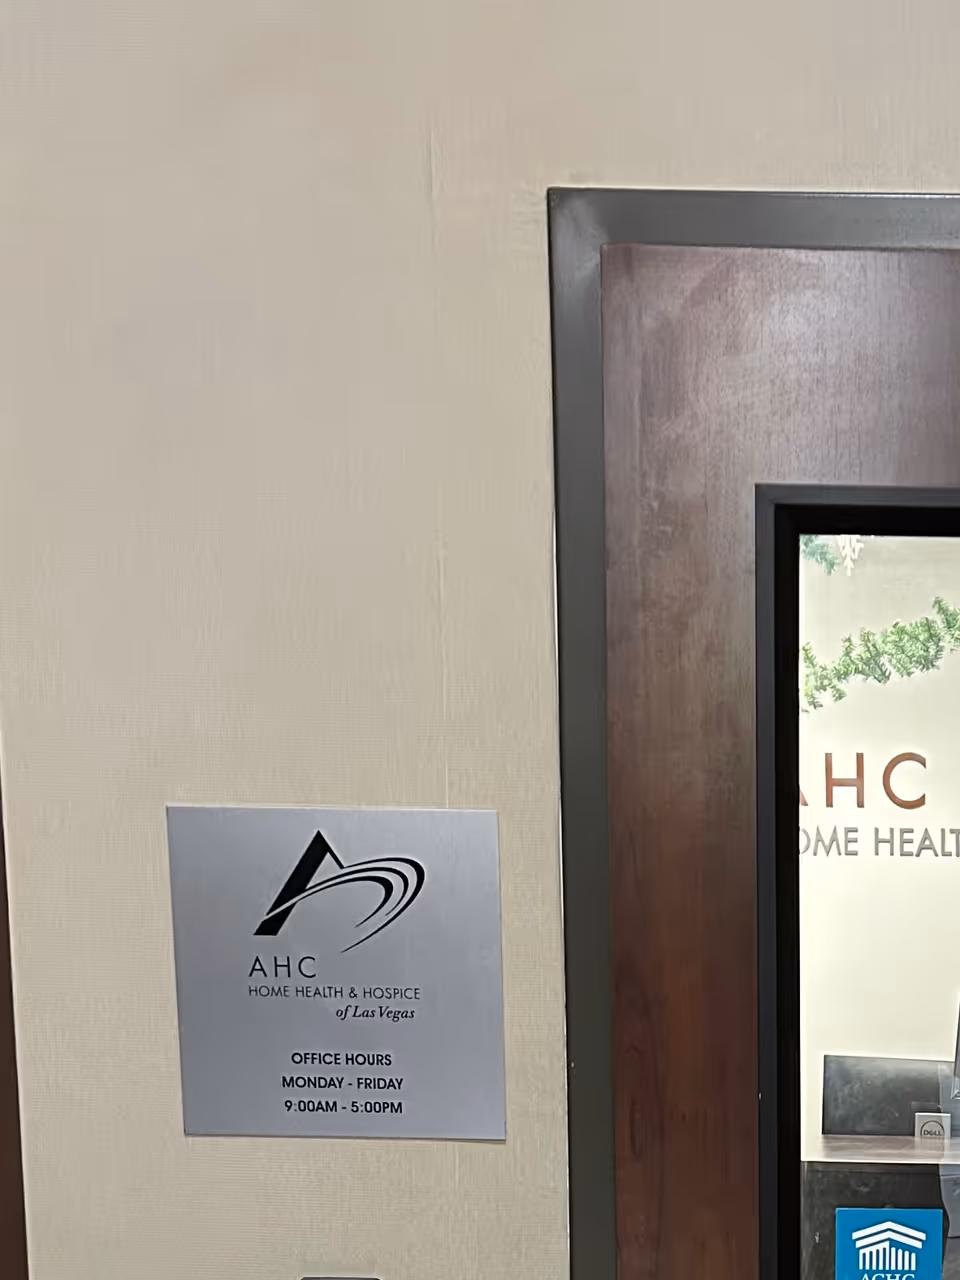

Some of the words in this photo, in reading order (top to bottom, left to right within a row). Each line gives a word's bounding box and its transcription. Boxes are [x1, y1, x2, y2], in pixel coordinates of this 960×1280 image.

[799, 752, 927, 810] HC
[248, 955, 318, 978] AHC
[248, 985, 290, 998] HOME
[296, 986, 343, 999] HEALTH
[348, 987, 358, 999] &
[363, 987, 421, 1000] HOSPICE
[336, 1005, 351, 1021] of
[352, 1006, 376, 1019] Las
[378, 1006, 415, 1022] Vegas
[291, 1052, 342, 1066] OFFICE
[345, 1053, 392, 1066] HOURS
[282, 1076, 345, 1090] MONDAY
[356, 1077, 404, 1090] FRIDAY
[284, 1100, 338, 1113] 9:00AM
[351, 1100, 403, 1114] 5:00PM
